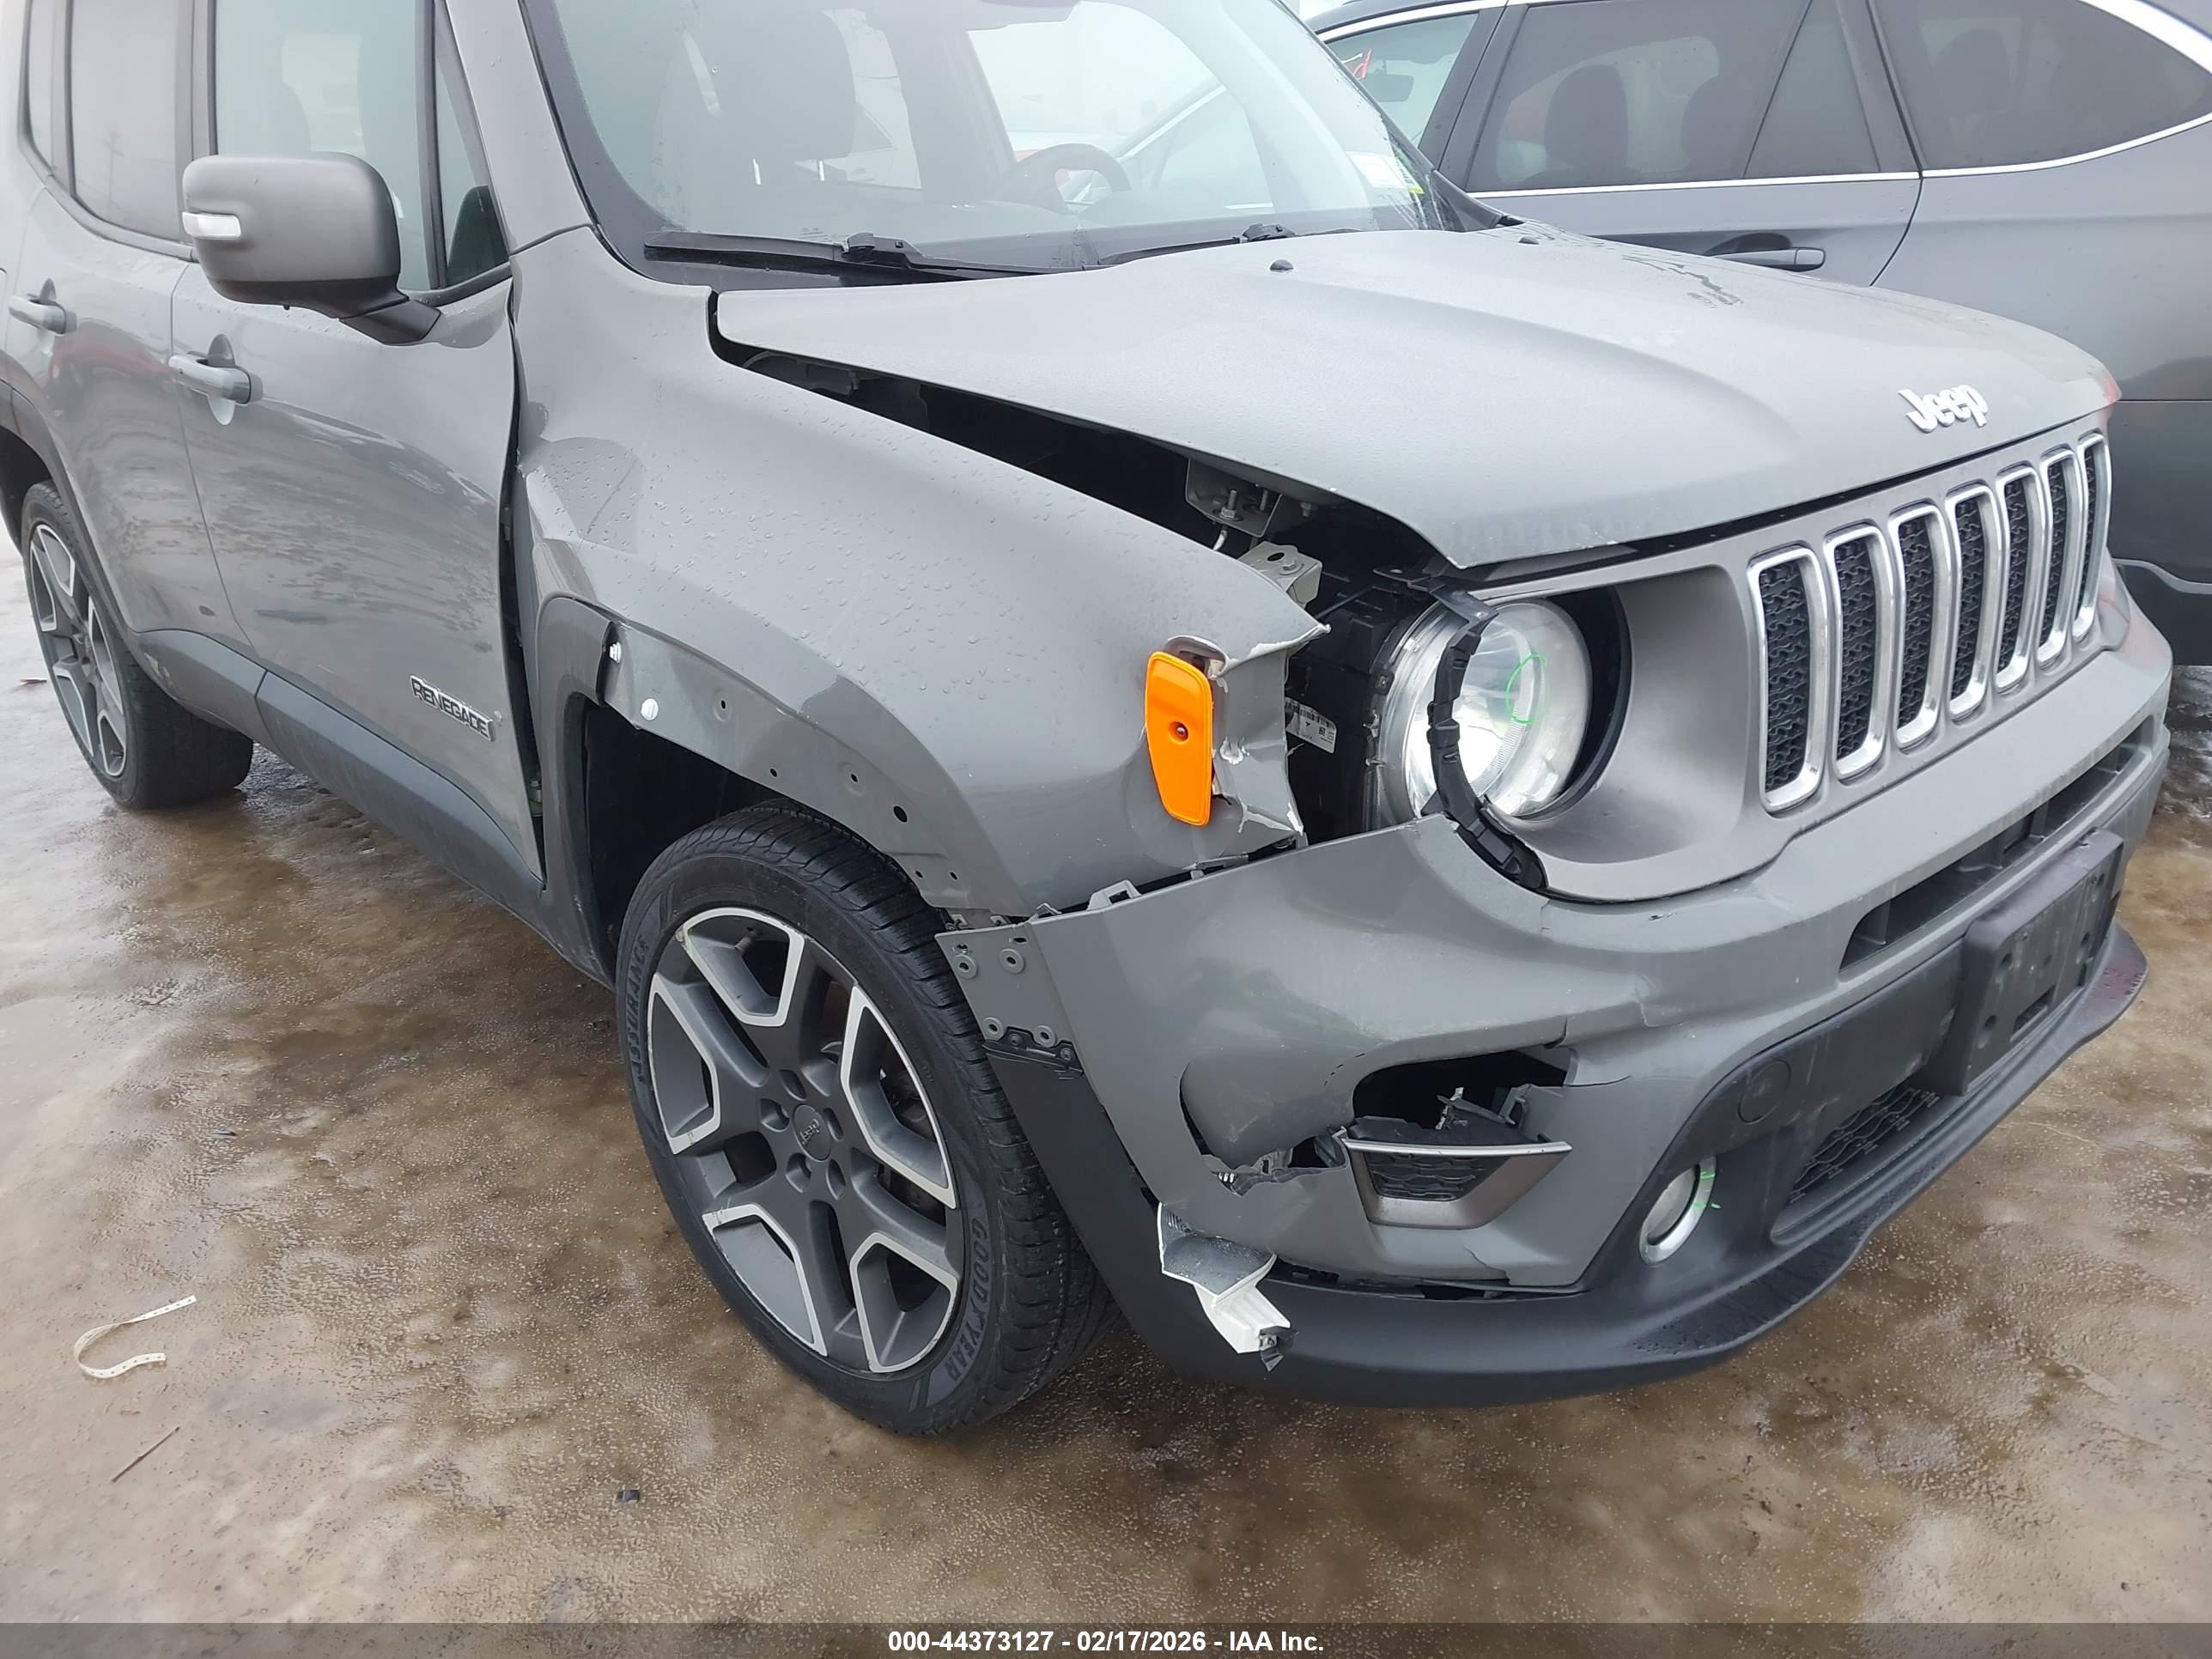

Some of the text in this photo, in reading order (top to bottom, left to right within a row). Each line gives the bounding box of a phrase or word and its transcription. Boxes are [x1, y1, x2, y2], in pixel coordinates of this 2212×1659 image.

[1897, 384, 1989, 434] Jeep
[410, 674, 495, 742] RENEGADE
[799, 1118, 820, 1145] Jeep
[947, 1217, 988, 1382] GOODYEAR
